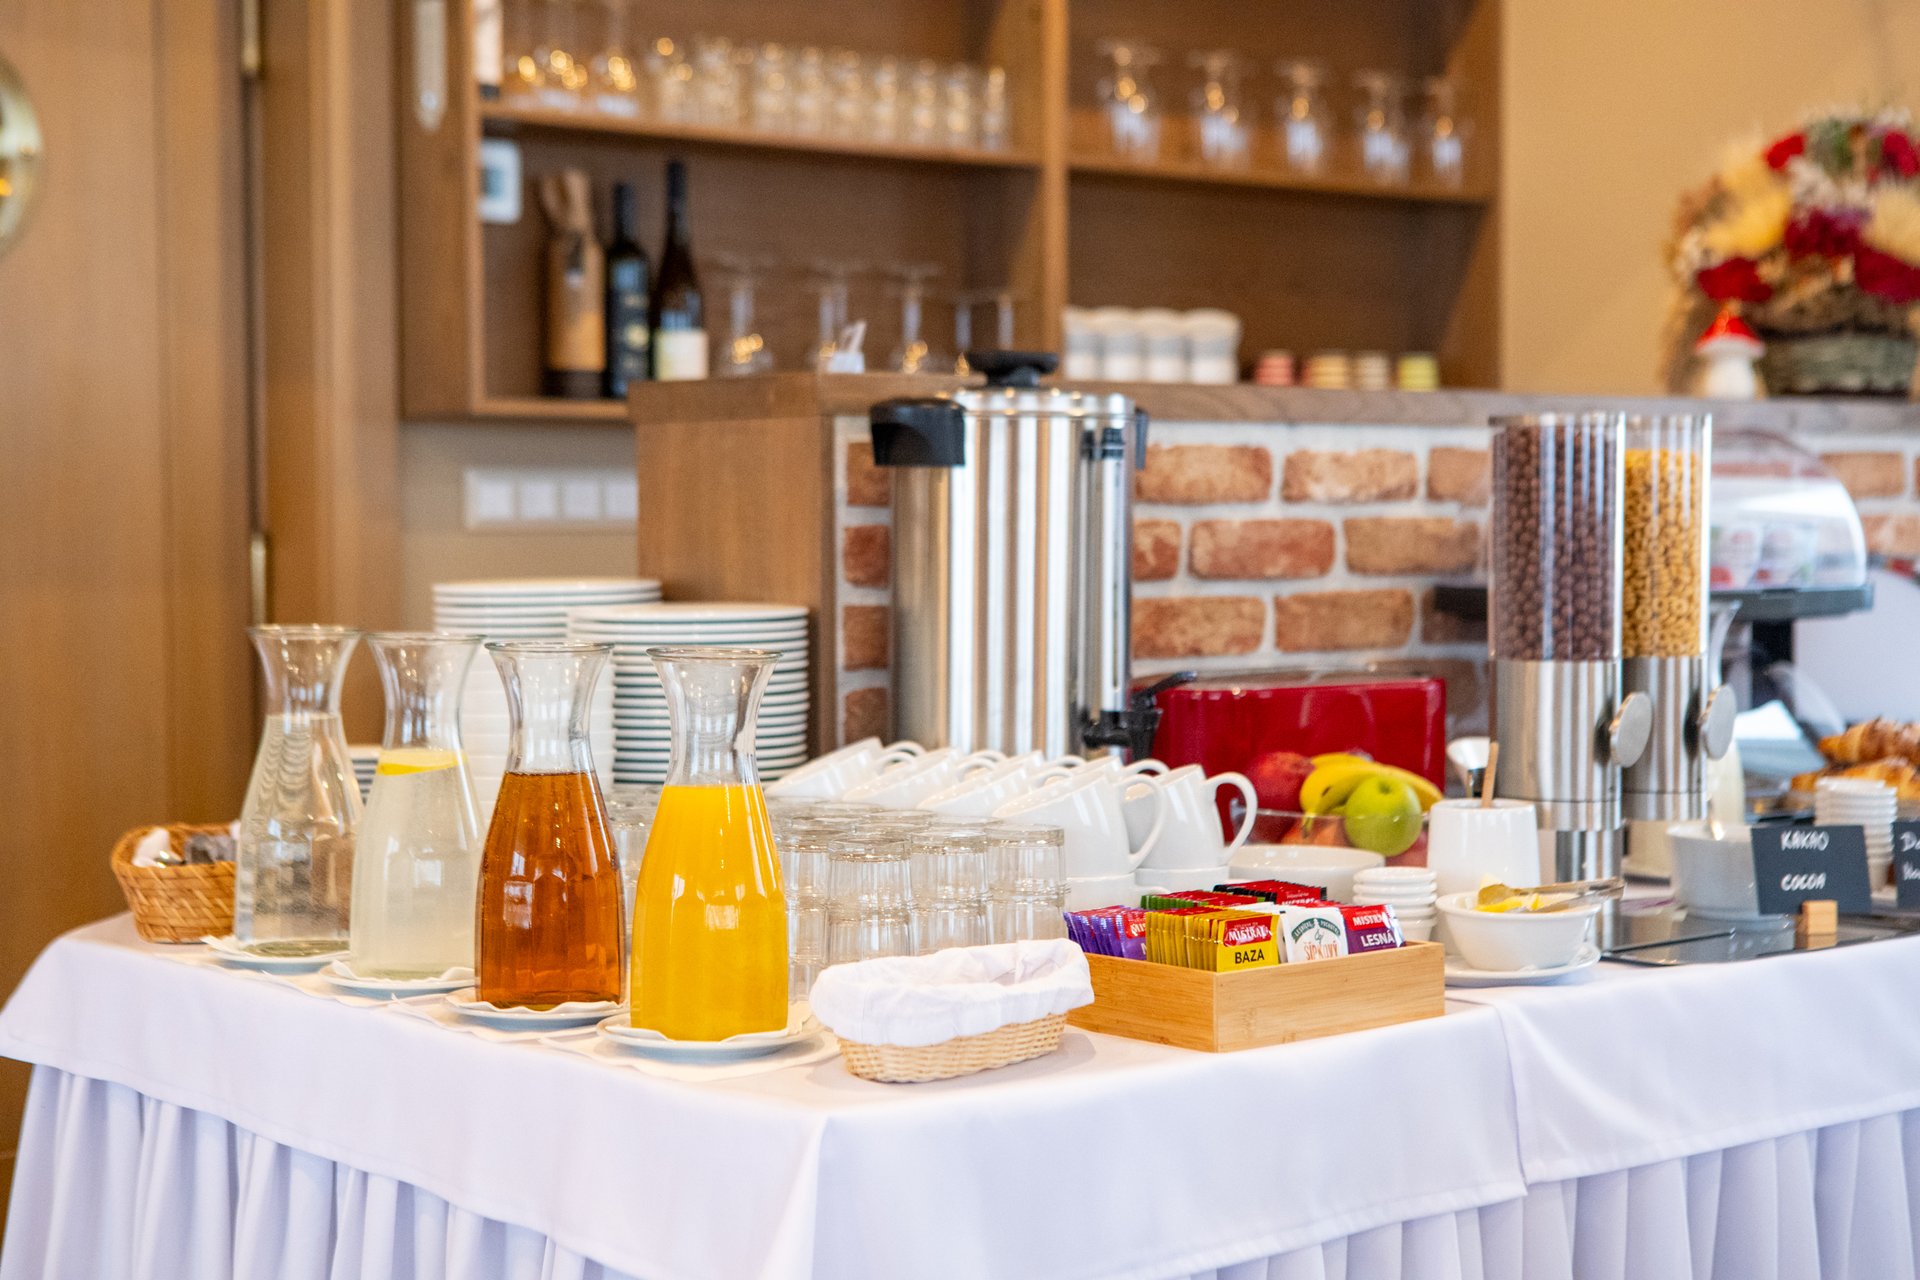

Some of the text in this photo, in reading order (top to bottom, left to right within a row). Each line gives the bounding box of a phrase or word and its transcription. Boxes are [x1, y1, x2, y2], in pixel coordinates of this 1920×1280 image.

[1781, 830, 1829, 851] KAKAO
[1781, 872, 1826, 891] COCOA
[1361, 930, 1395, 947] LESNÁ
[1234, 948, 1265, 964] BAZA
